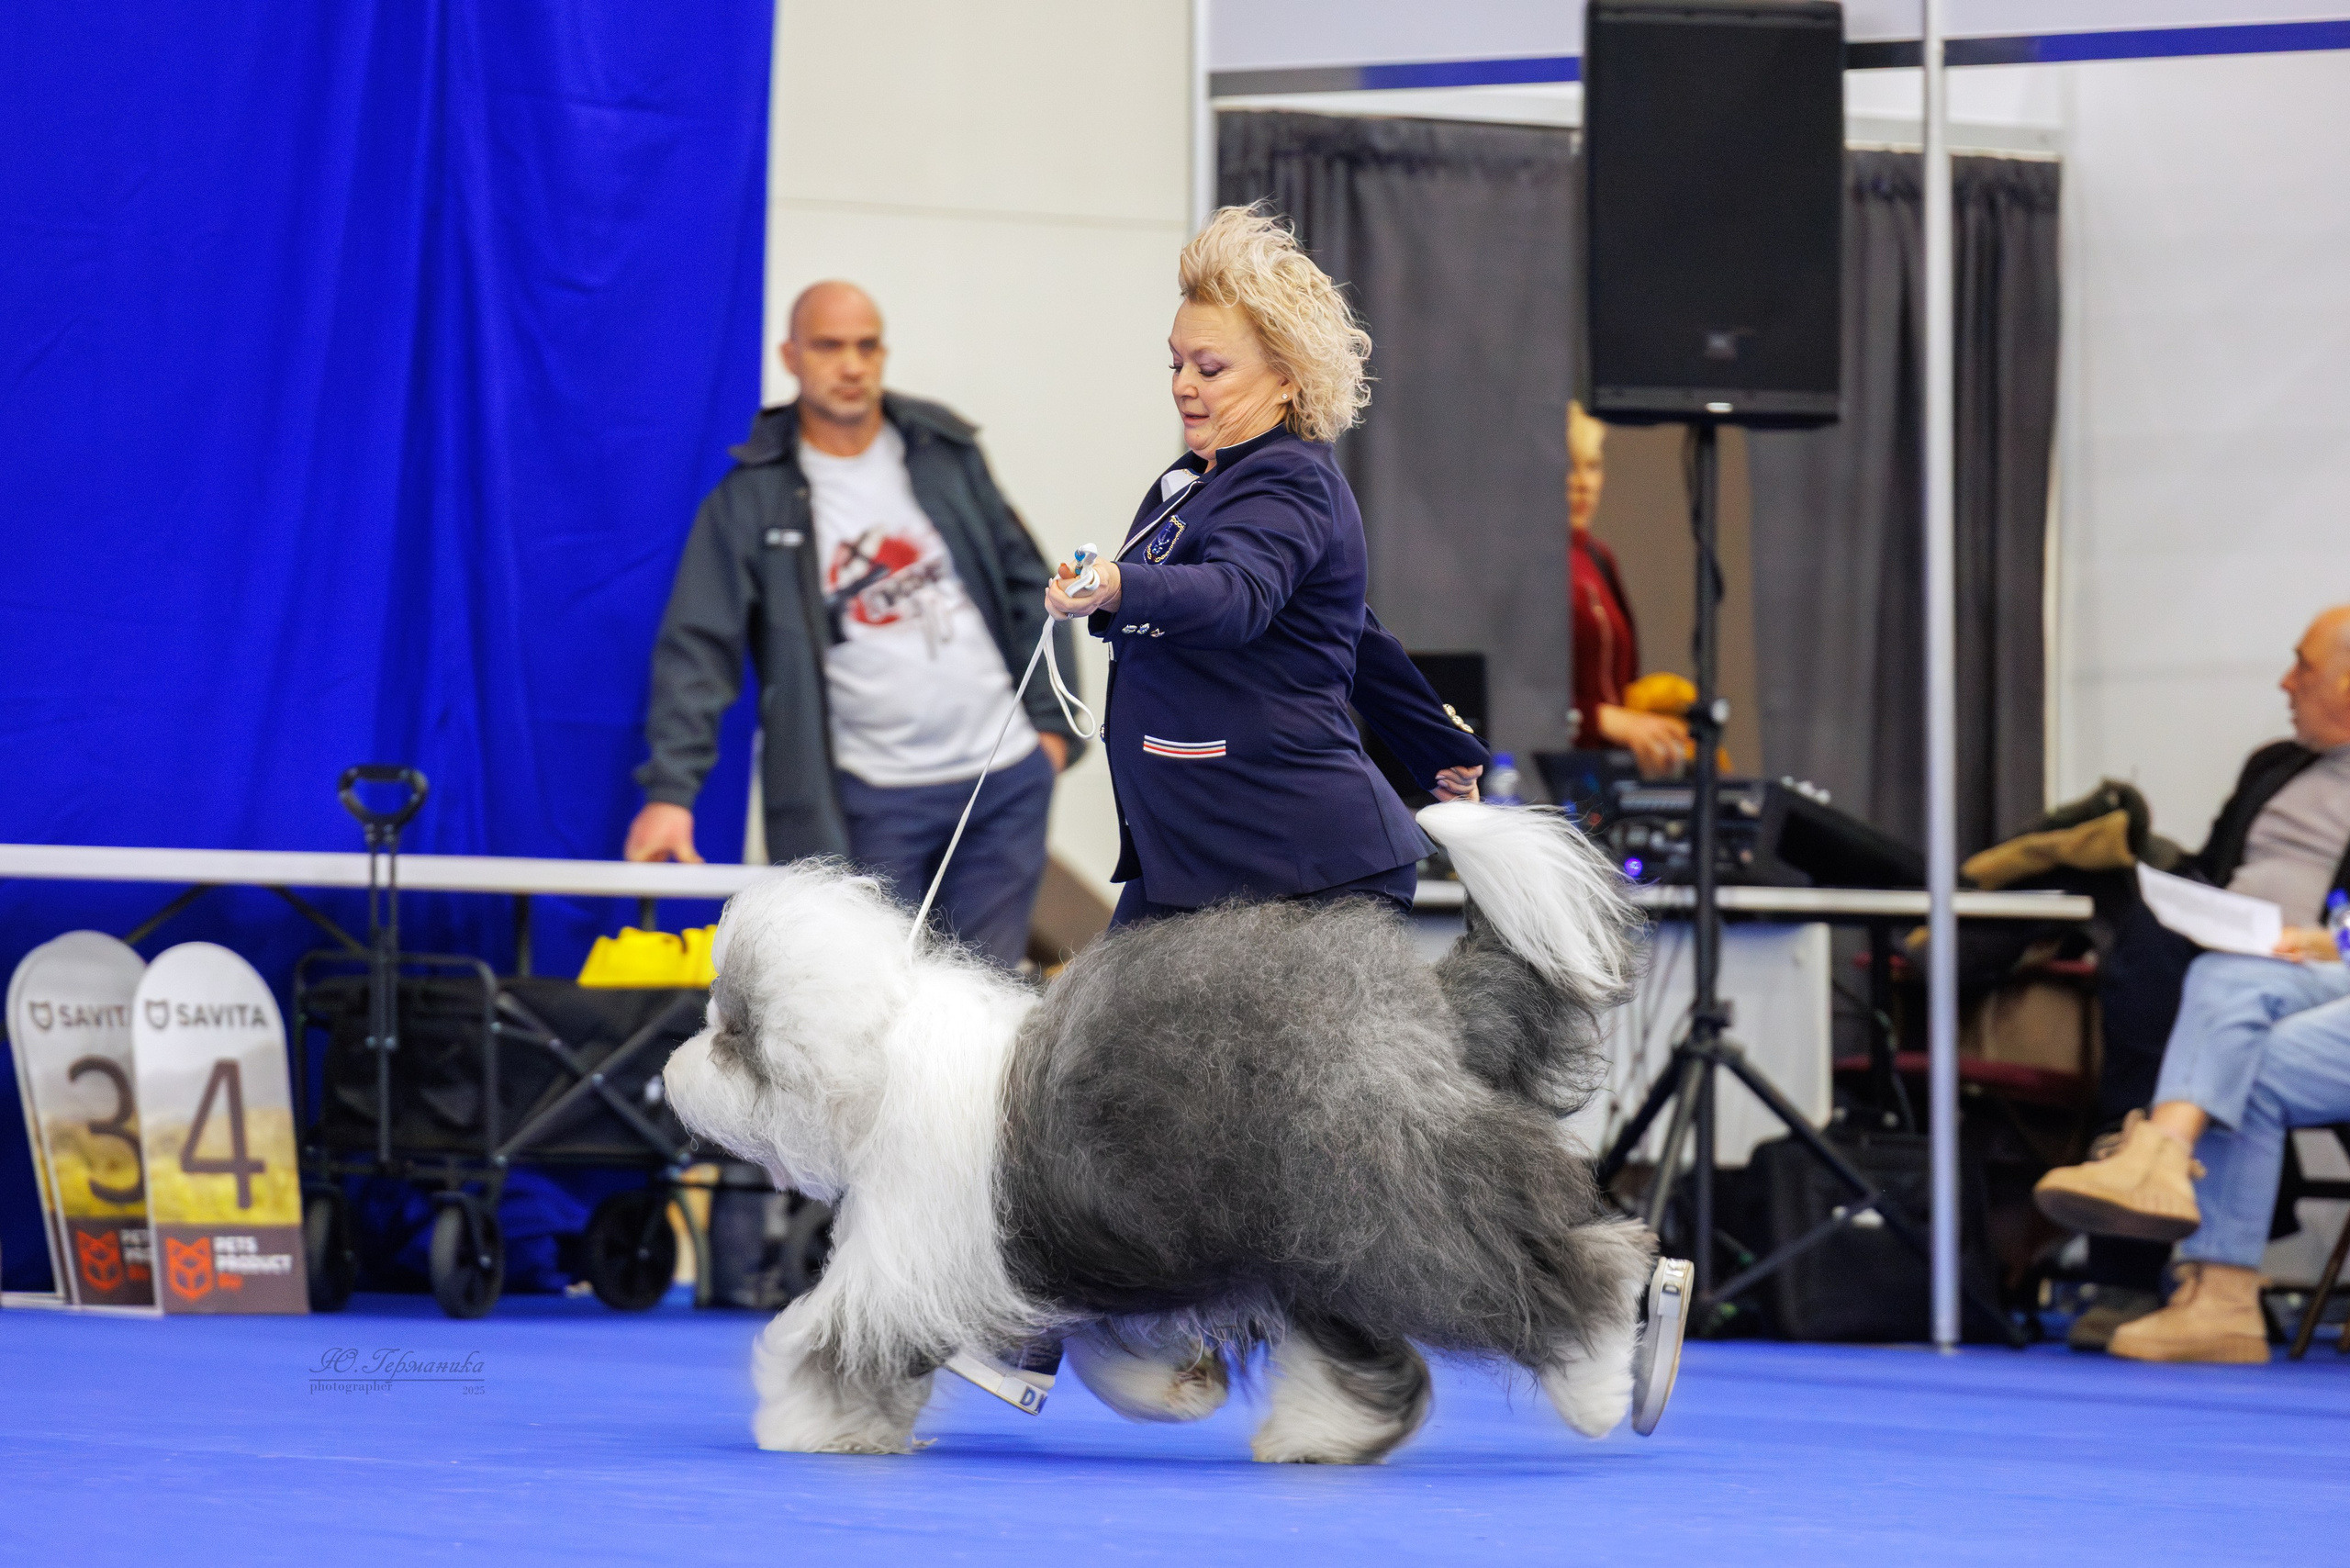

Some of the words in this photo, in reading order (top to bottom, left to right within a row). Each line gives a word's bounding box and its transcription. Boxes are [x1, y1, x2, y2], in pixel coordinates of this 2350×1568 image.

[59, 1004, 133, 1027] SAVIT
[176, 1003, 268, 1028] SAVITA
[68, 1054, 147, 1204] 3
[181, 1058, 266, 1209] 4
